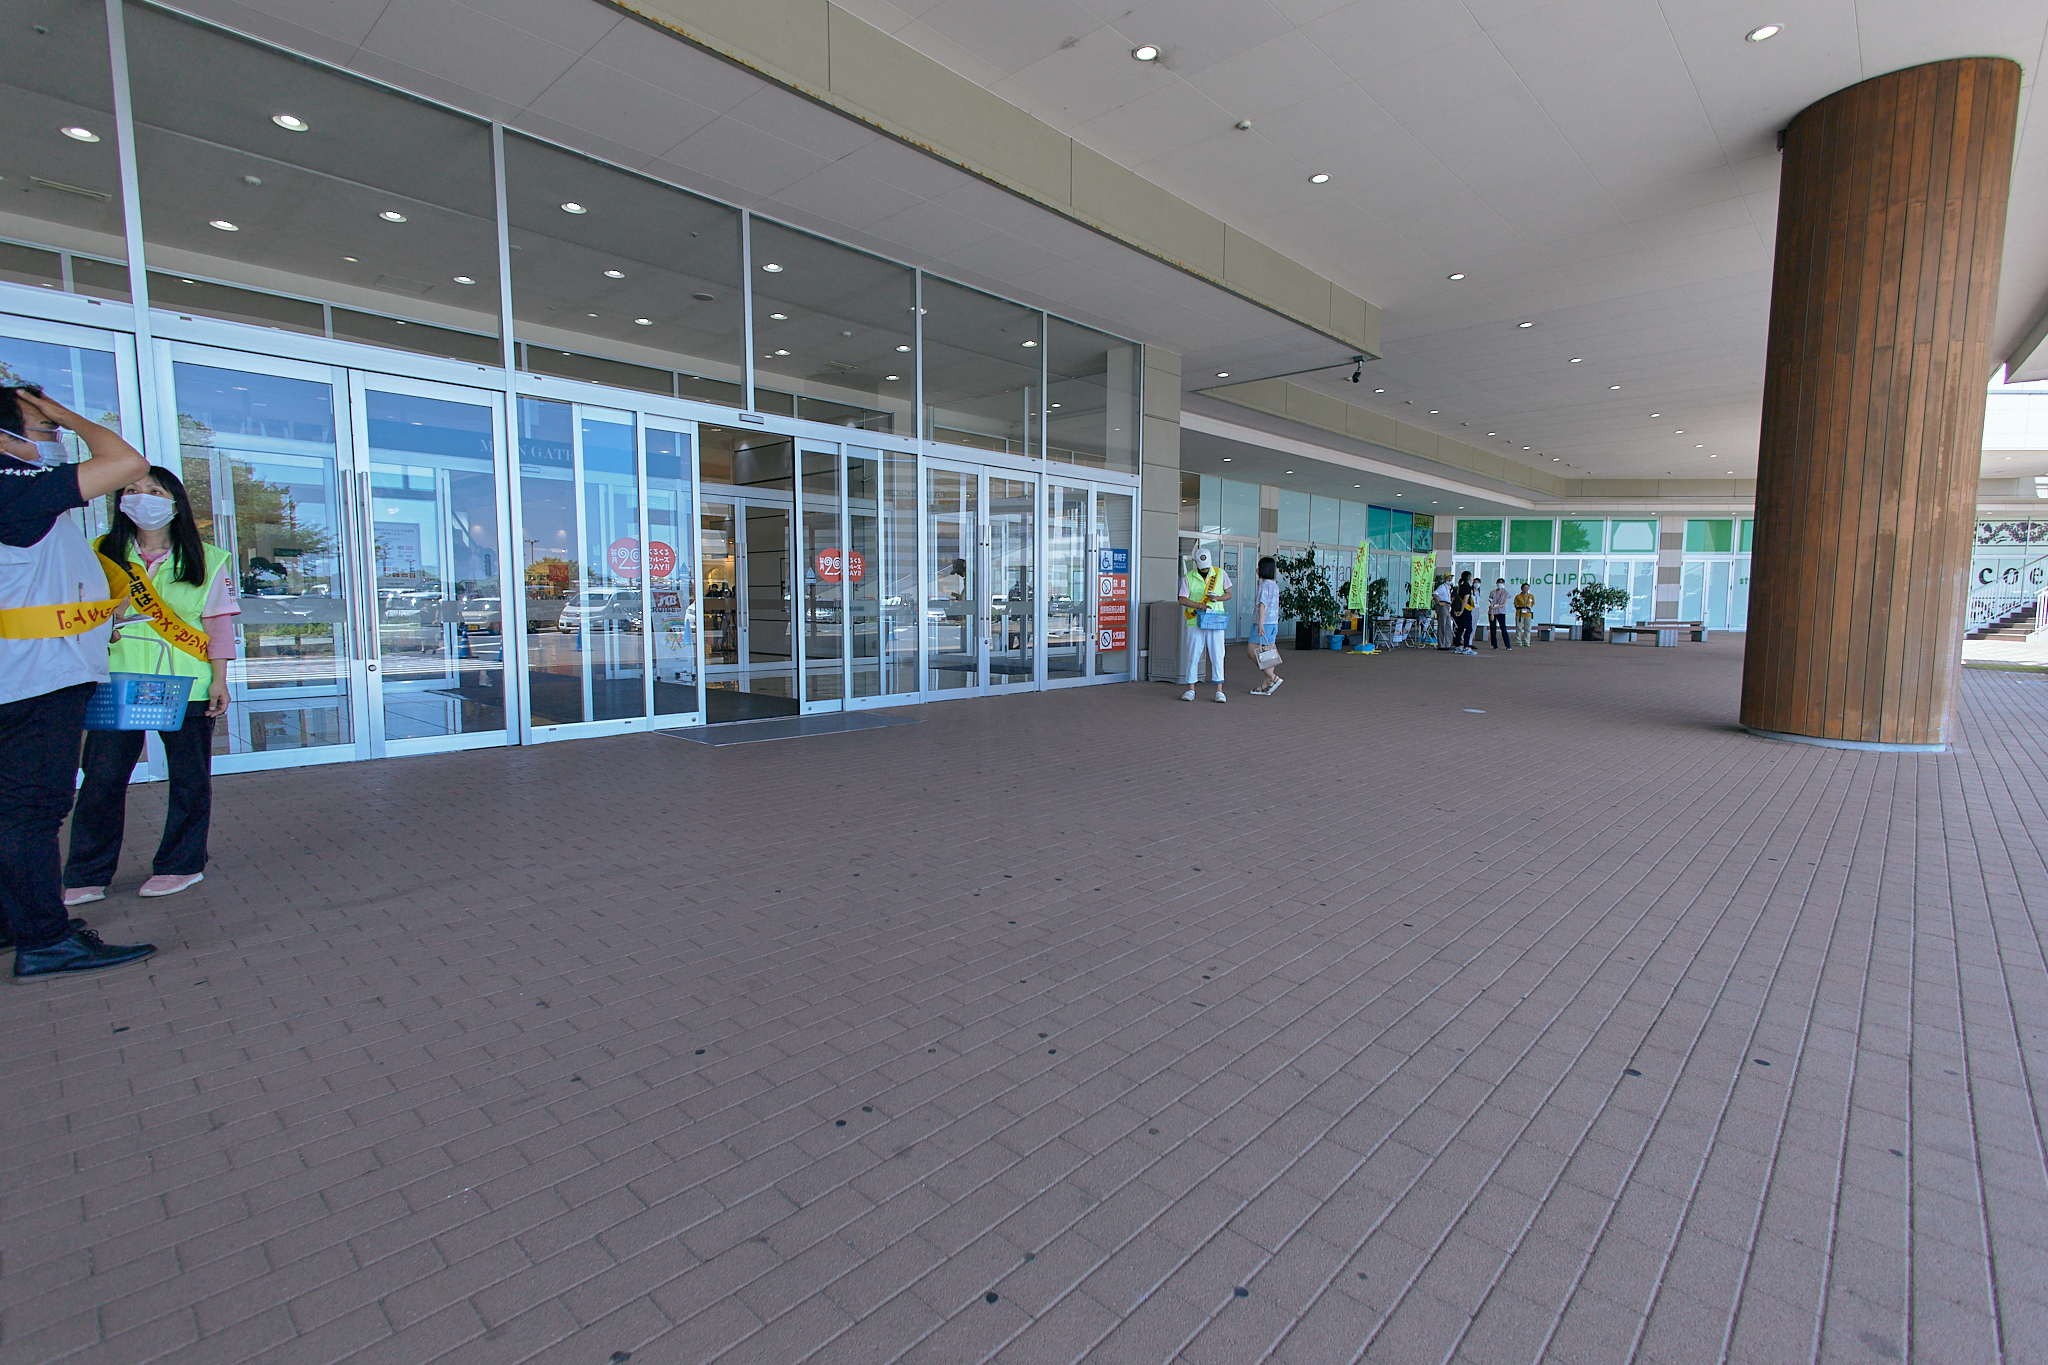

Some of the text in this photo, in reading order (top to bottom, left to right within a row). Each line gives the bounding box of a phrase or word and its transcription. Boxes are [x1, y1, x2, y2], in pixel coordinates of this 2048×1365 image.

[480, 439, 527, 457] MN
[617, 547, 640, 569] 29
[1543, 573, 1577, 585] CLIP
[658, 595, 678, 607] JTB
